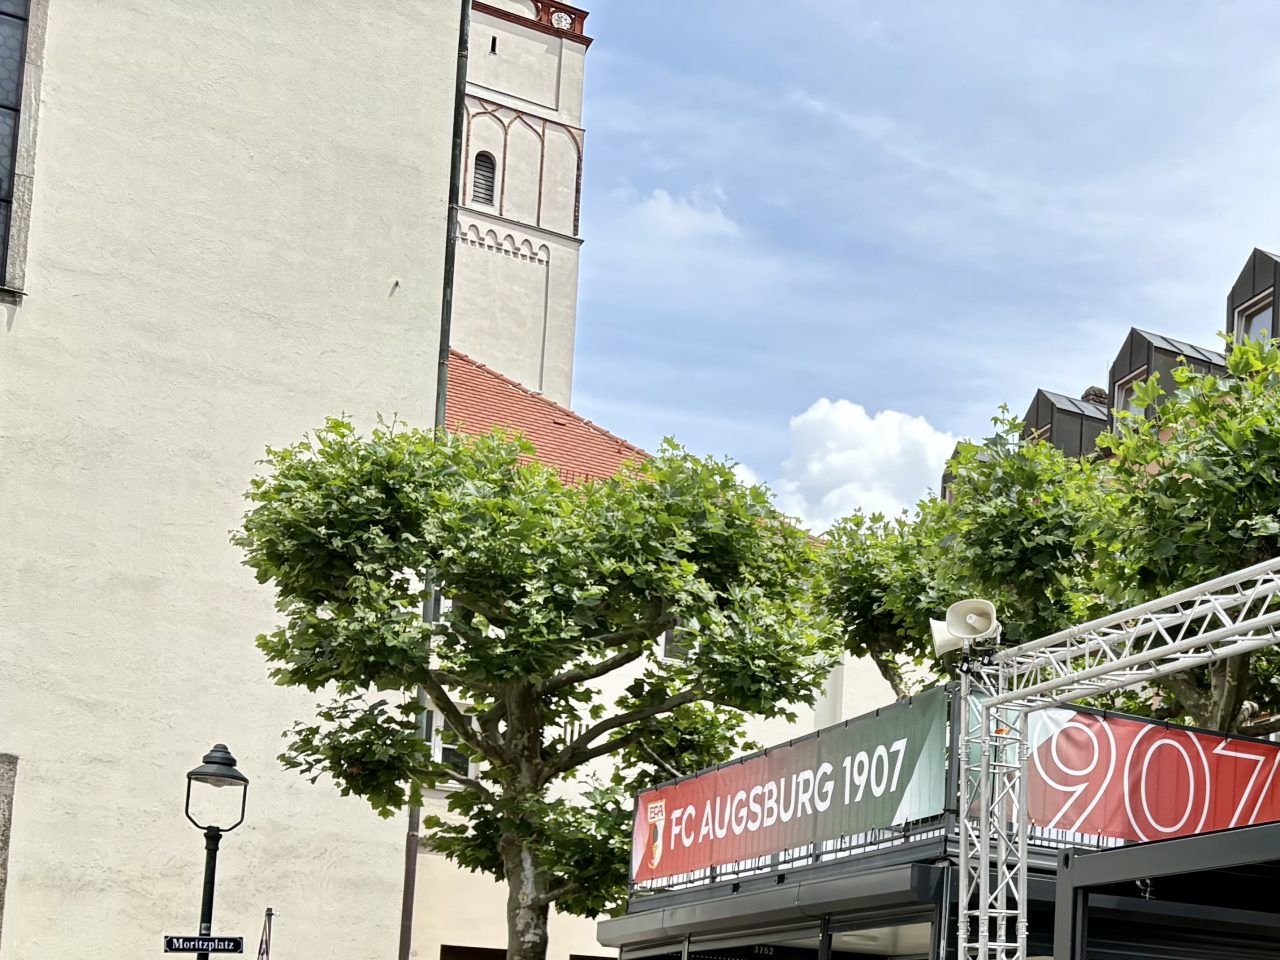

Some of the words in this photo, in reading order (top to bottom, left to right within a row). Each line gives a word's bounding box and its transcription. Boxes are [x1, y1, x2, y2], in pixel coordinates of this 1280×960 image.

[669, 804, 696, 851] FC
[698, 762, 835, 843] AUGSBURG
[842, 737, 908, 805] 1907
[172, 938, 235, 951] Moritzplatz
